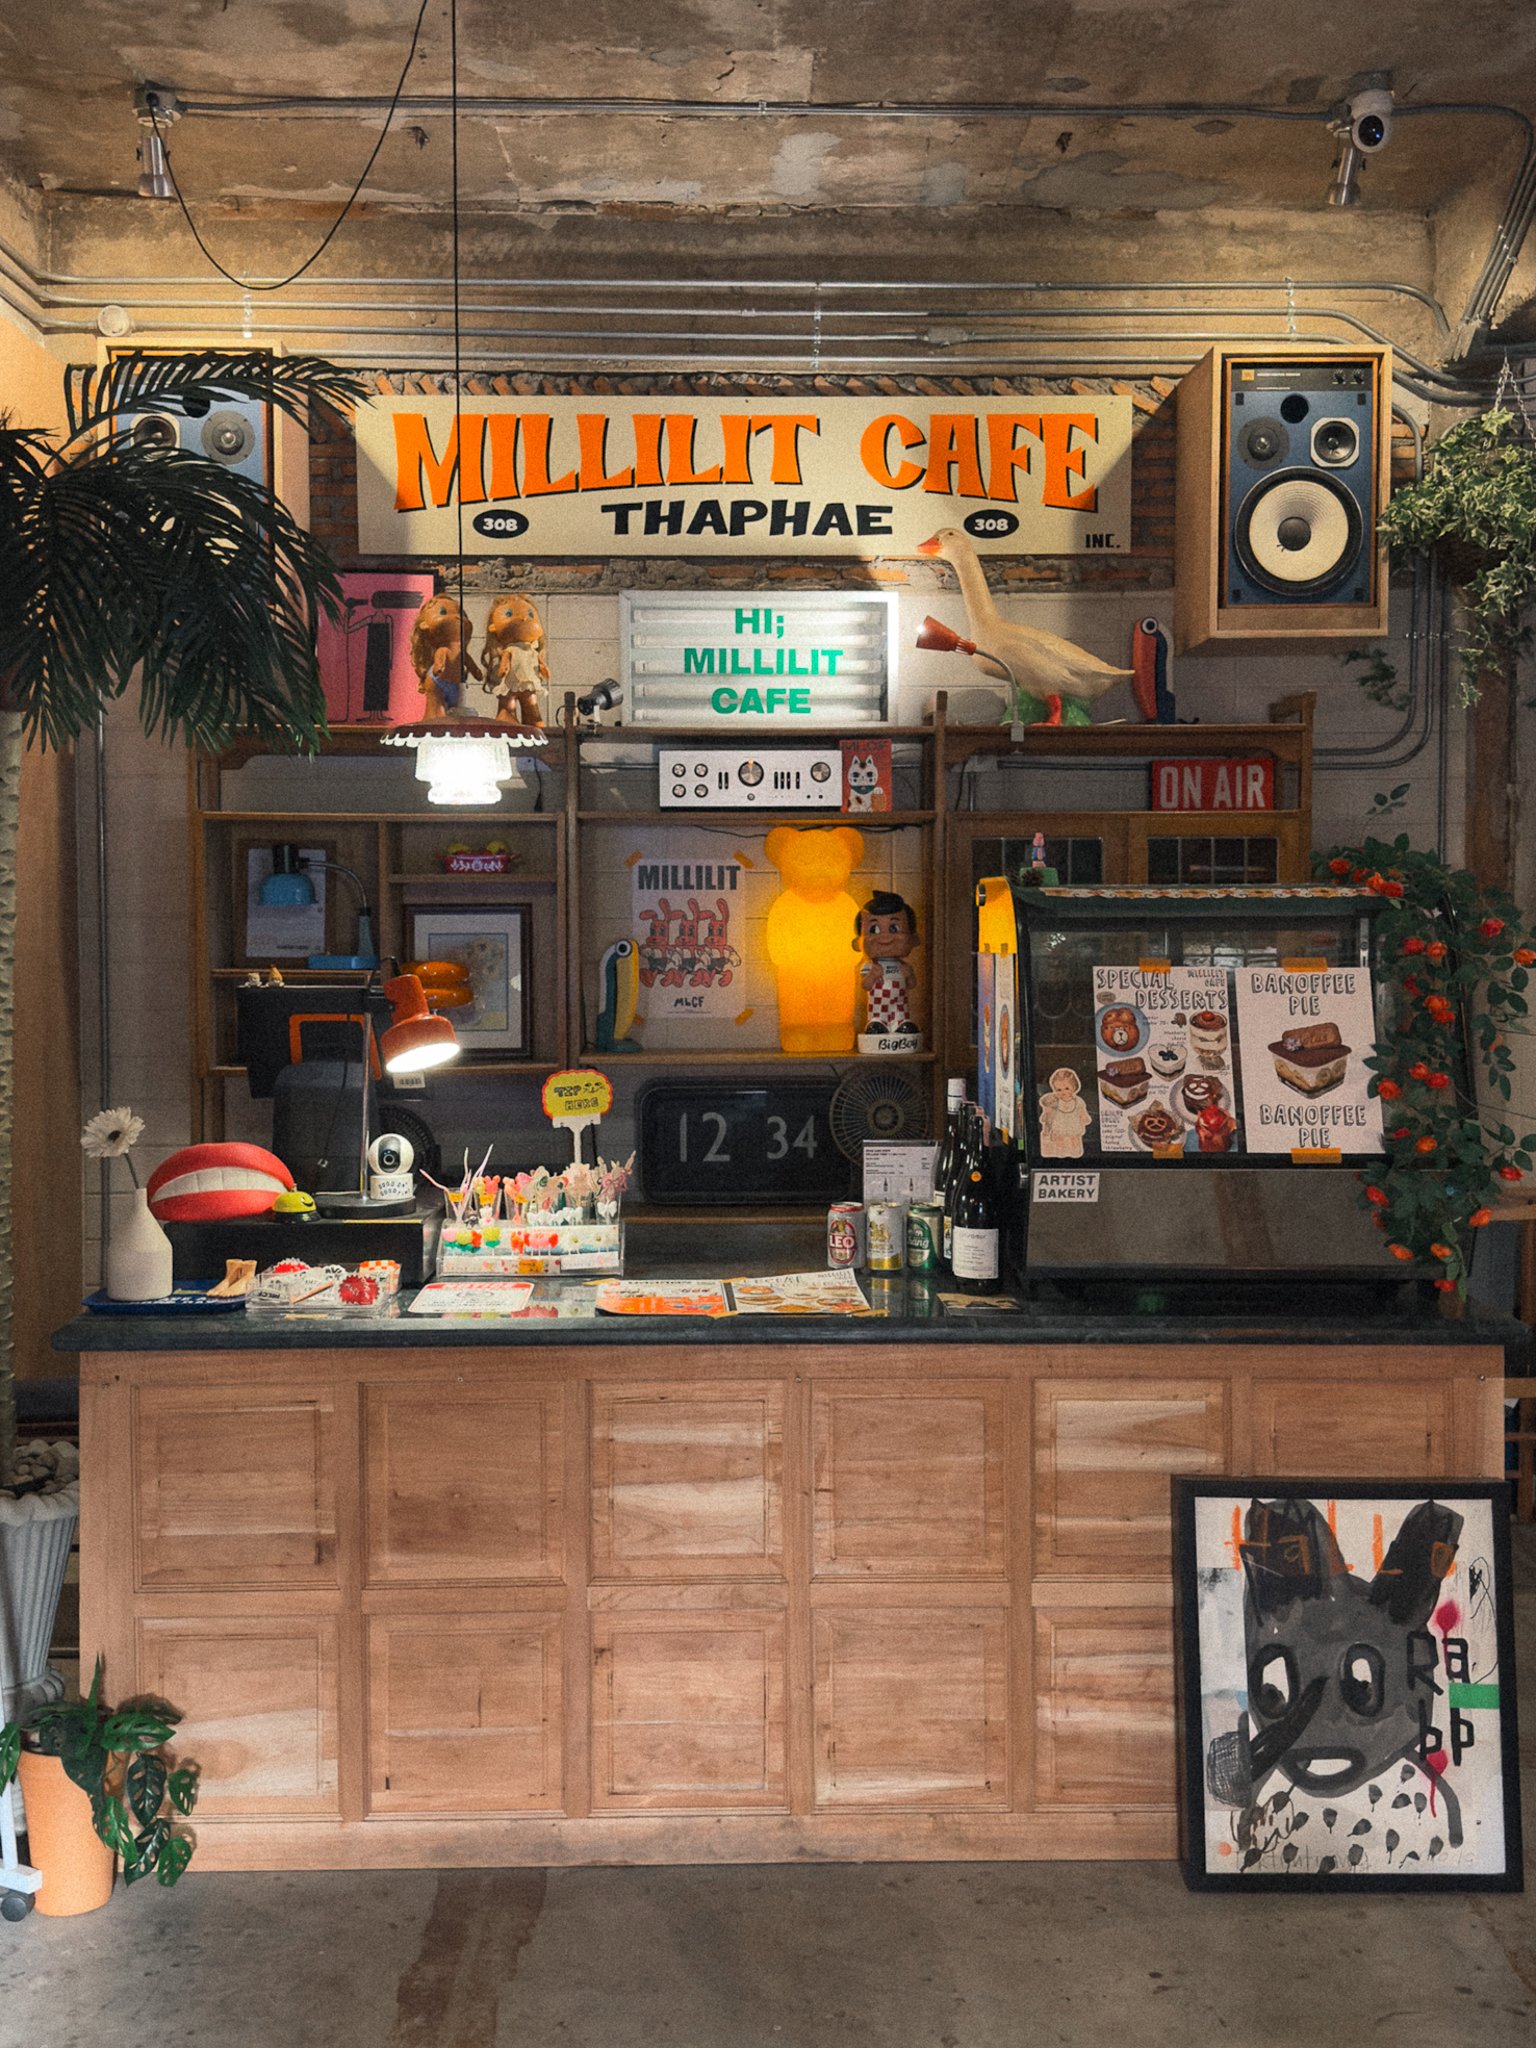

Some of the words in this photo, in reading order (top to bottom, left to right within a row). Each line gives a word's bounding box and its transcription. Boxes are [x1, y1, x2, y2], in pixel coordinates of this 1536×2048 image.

[392, 413, 821, 513] MILLILIT
[860, 413, 1099, 513] CAFE
[482, 517, 518, 533] 308
[601, 499, 893, 537] THAPHAE
[974, 518, 1009, 532] 308
[1085, 534, 1121, 550] INC.
[735, 608, 784, 639] HI;
[684, 647, 844, 676] MILLILIT
[711, 688, 812, 714] CAFE
[1160, 766, 1202, 810] ON
[1213, 764, 1265, 809] AIR
[638, 865, 741, 890] MILLILIT
[1097, 969, 1174, 989] SPECIAL
[1252, 973, 1356, 994] BANOFFEE
[1135, 990, 1228, 1010] DESSERTS
[1289, 996, 1321, 1016] PIE
[1260, 1104, 1366, 1126] BANOFFEE
[679, 1112, 731, 1162] 12
[766, 1115, 818, 1159] 34
[1299, 1128, 1331, 1148] PIE
[1039, 1175, 1096, 1186] ARTIST
[1038, 1188, 1095, 1199] BAKERY
[829, 1235, 855, 1249] LEO
